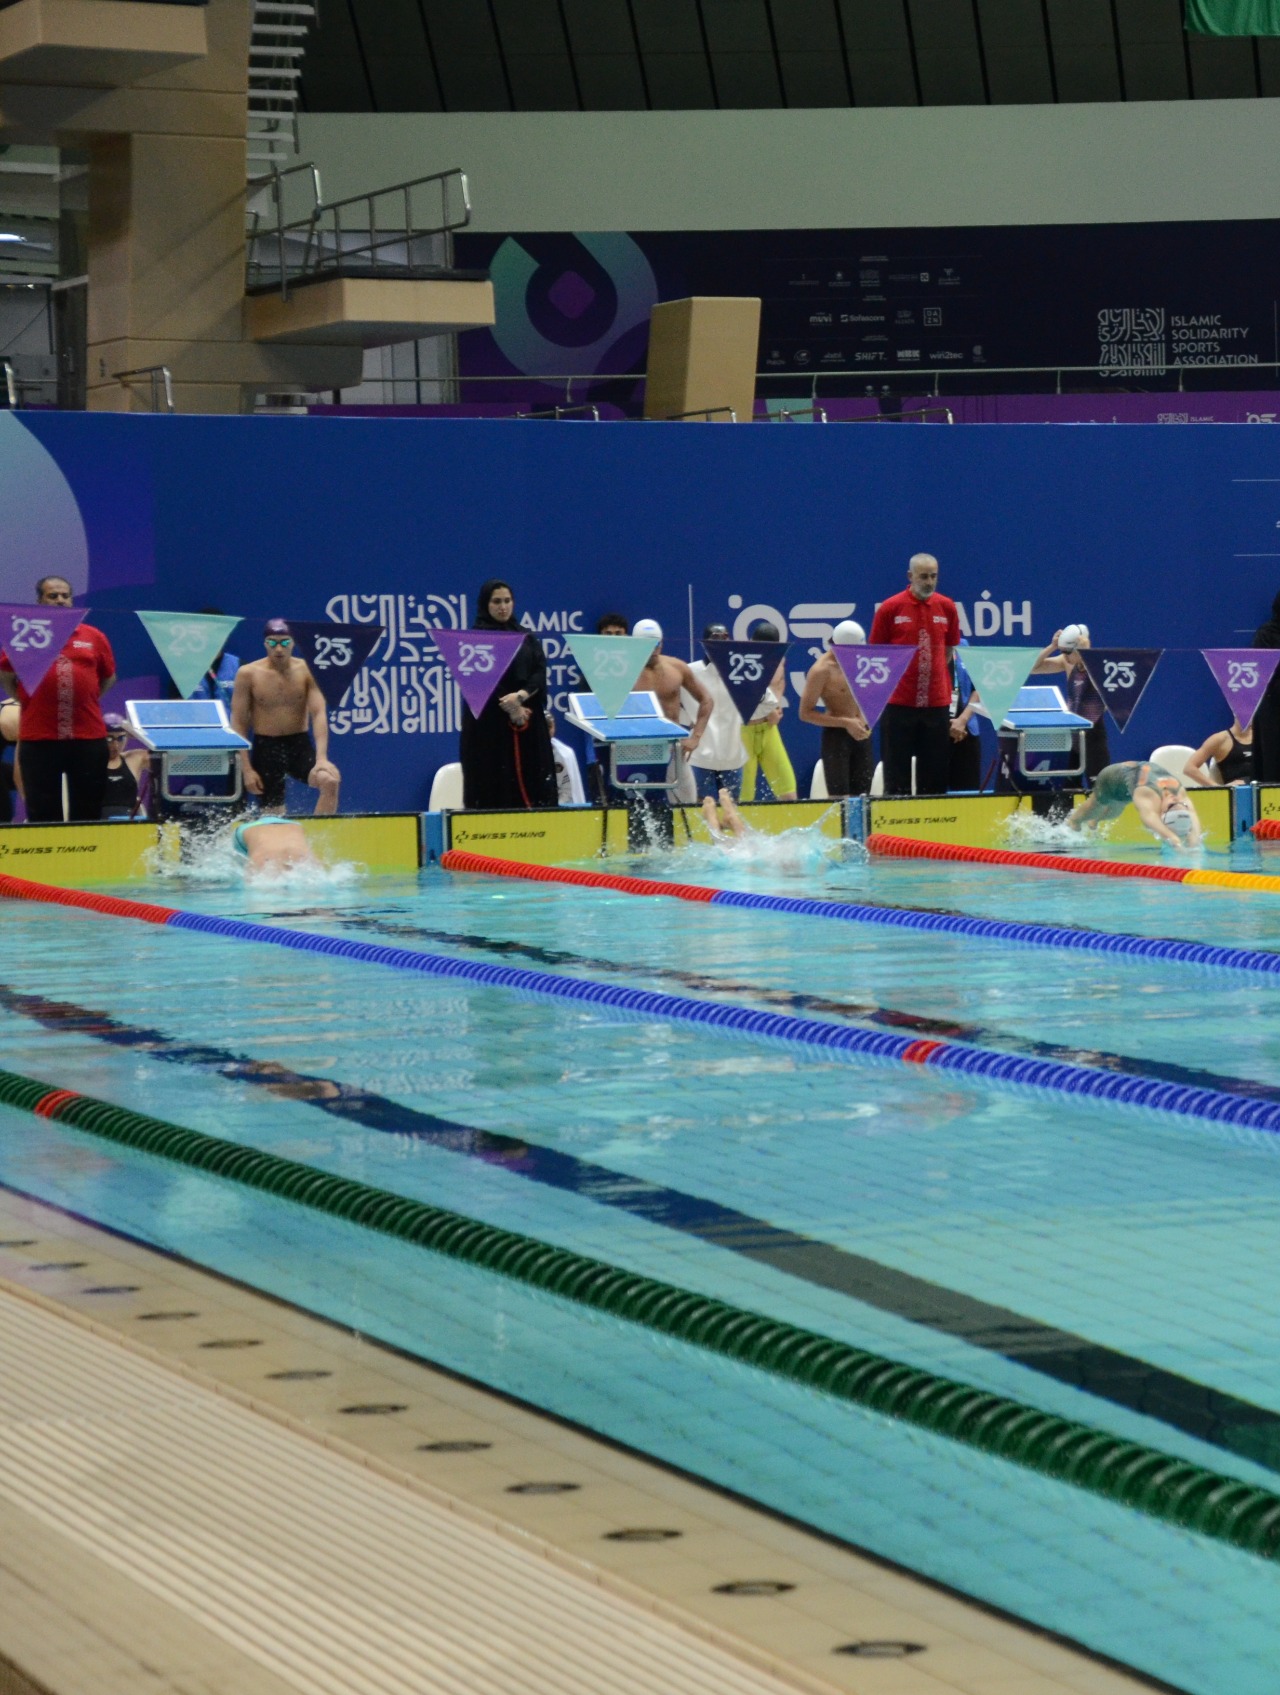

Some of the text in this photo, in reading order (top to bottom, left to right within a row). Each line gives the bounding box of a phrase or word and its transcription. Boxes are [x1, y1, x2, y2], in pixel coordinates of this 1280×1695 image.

[1171, 315, 1221, 327] ISLAMIC
[1172, 328, 1249, 340] SOLIDARITY
[1172, 342, 1220, 353] SPORTS
[1174, 354, 1259, 367] ASSOCIATION
[11, 615, 53, 651] 25
[520, 611, 583, 632] AMIC
[314, 634, 352, 669] 25
[457, 641, 496, 675] 25
[729, 651, 764, 684] 25
[856, 654, 890, 687] 25
[1103, 659, 1136, 692] 25
[1227, 660, 1260, 692] 25
[1001, 754, 1010, 779] 4
[888, 815, 957, 825] SWISS TIMING
[471, 830, 546, 841] SWISS TIMING
[11, 844, 97, 856] SWISS TIMING
